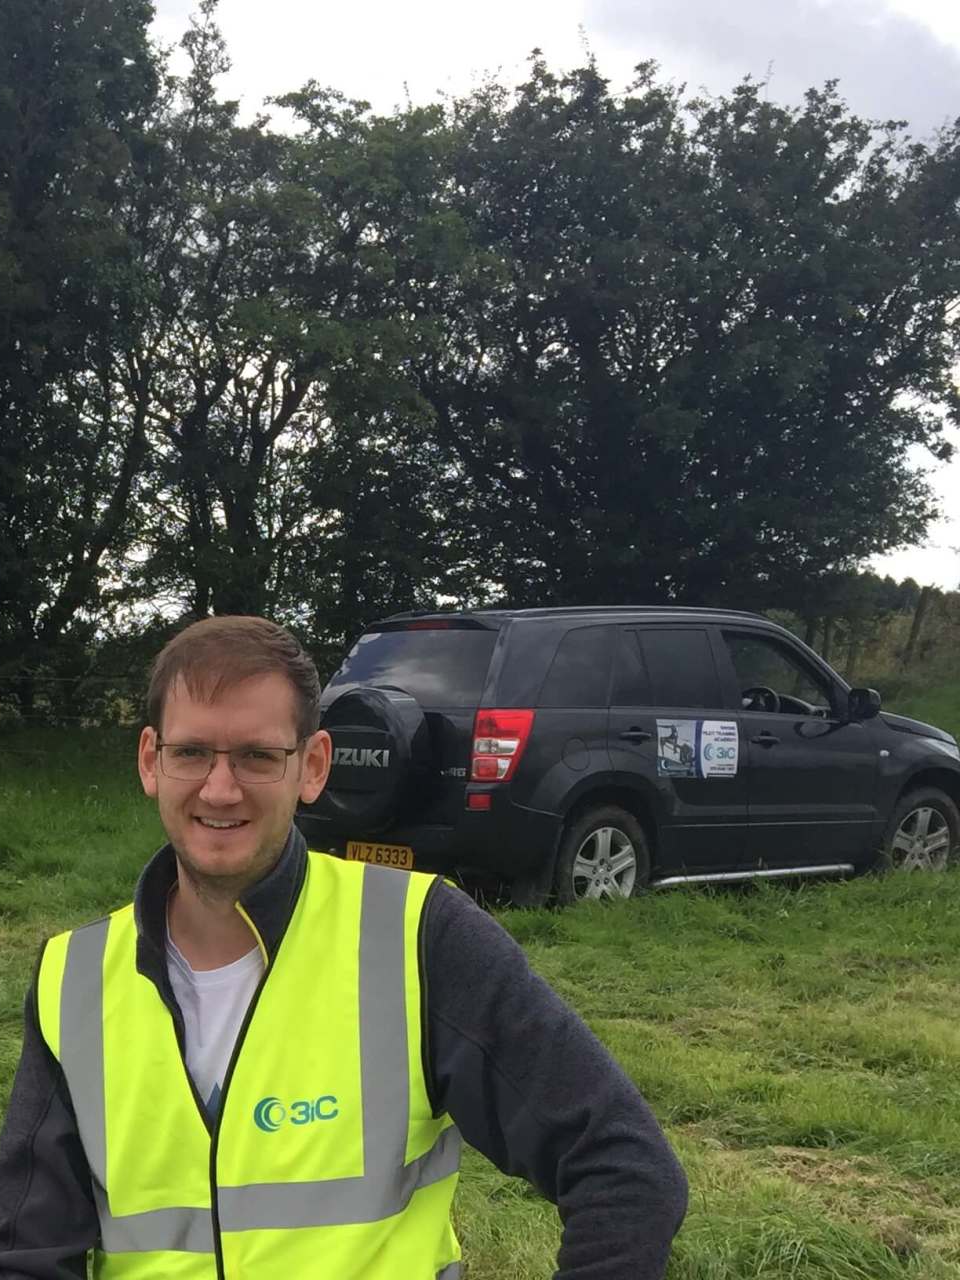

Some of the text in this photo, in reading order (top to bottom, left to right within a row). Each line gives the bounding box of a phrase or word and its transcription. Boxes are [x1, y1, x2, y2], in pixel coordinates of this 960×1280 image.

[351, 844, 408, 866] VLZ 6333
[290, 1095, 339, 1125] 3iC
